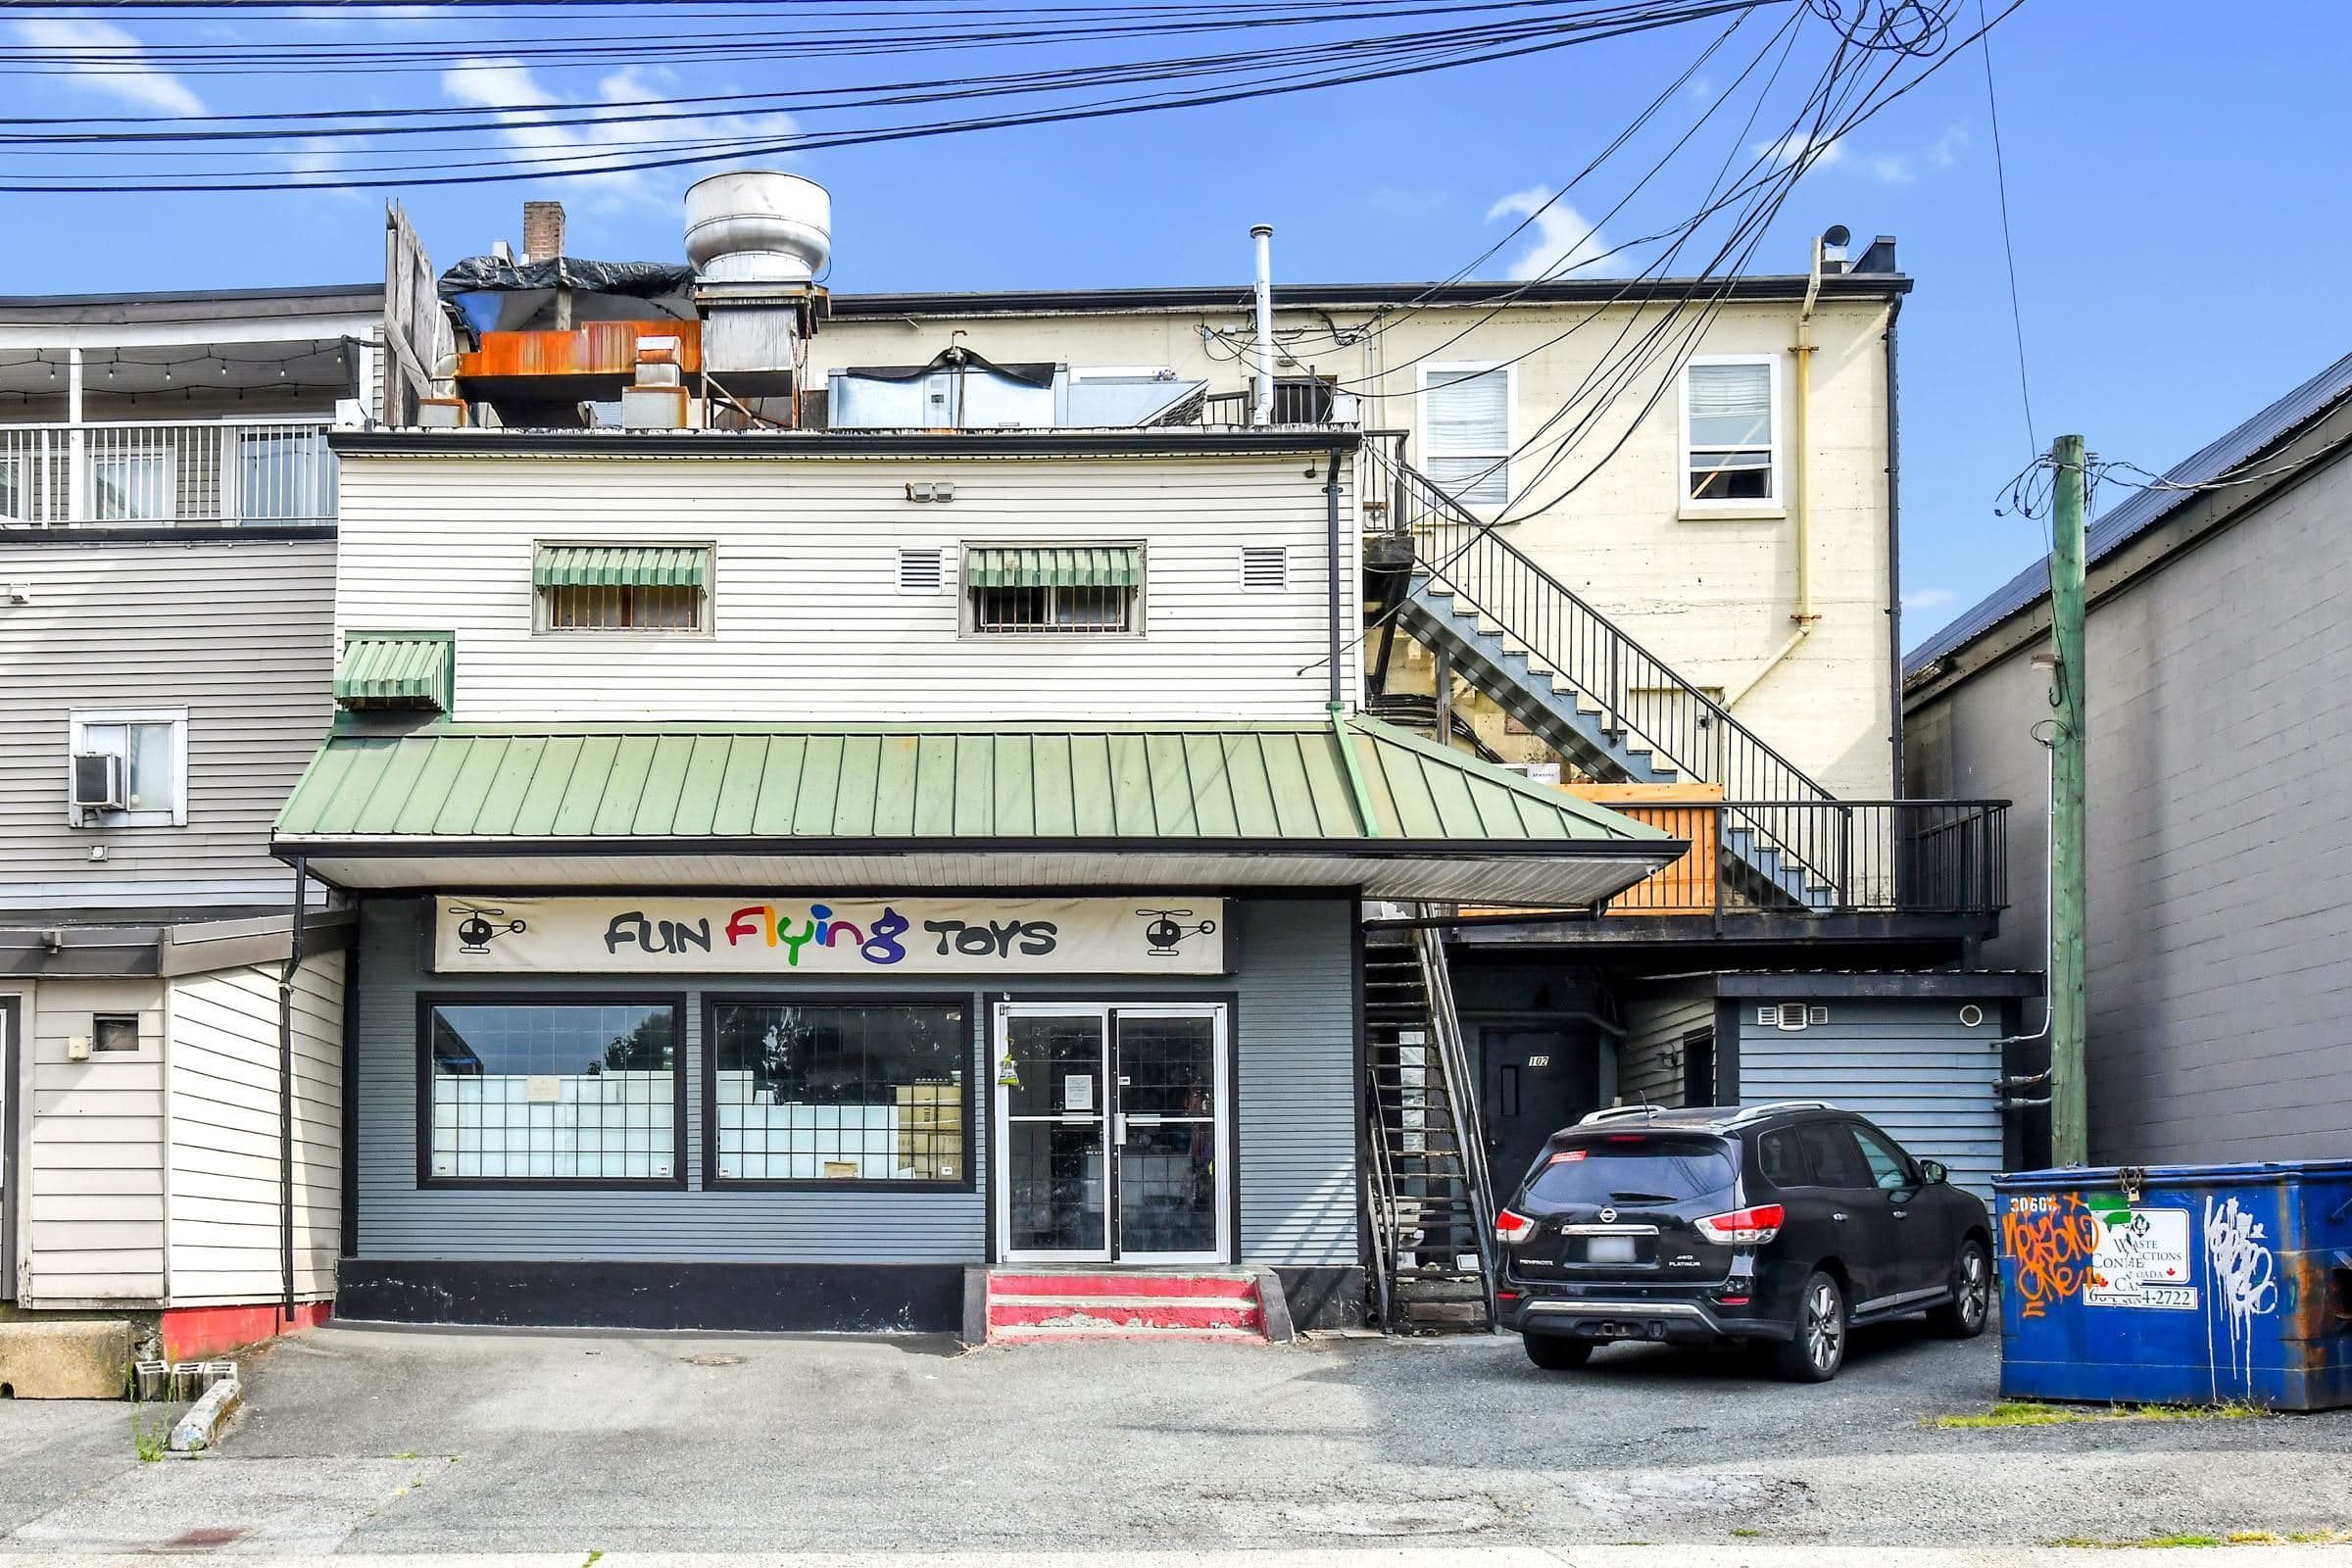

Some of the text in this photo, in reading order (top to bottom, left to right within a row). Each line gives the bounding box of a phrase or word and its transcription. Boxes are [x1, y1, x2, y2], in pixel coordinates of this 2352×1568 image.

[604, 905, 1058, 966] FUN Flying TOYS
[1530, 1055, 1549, 1066] 102
